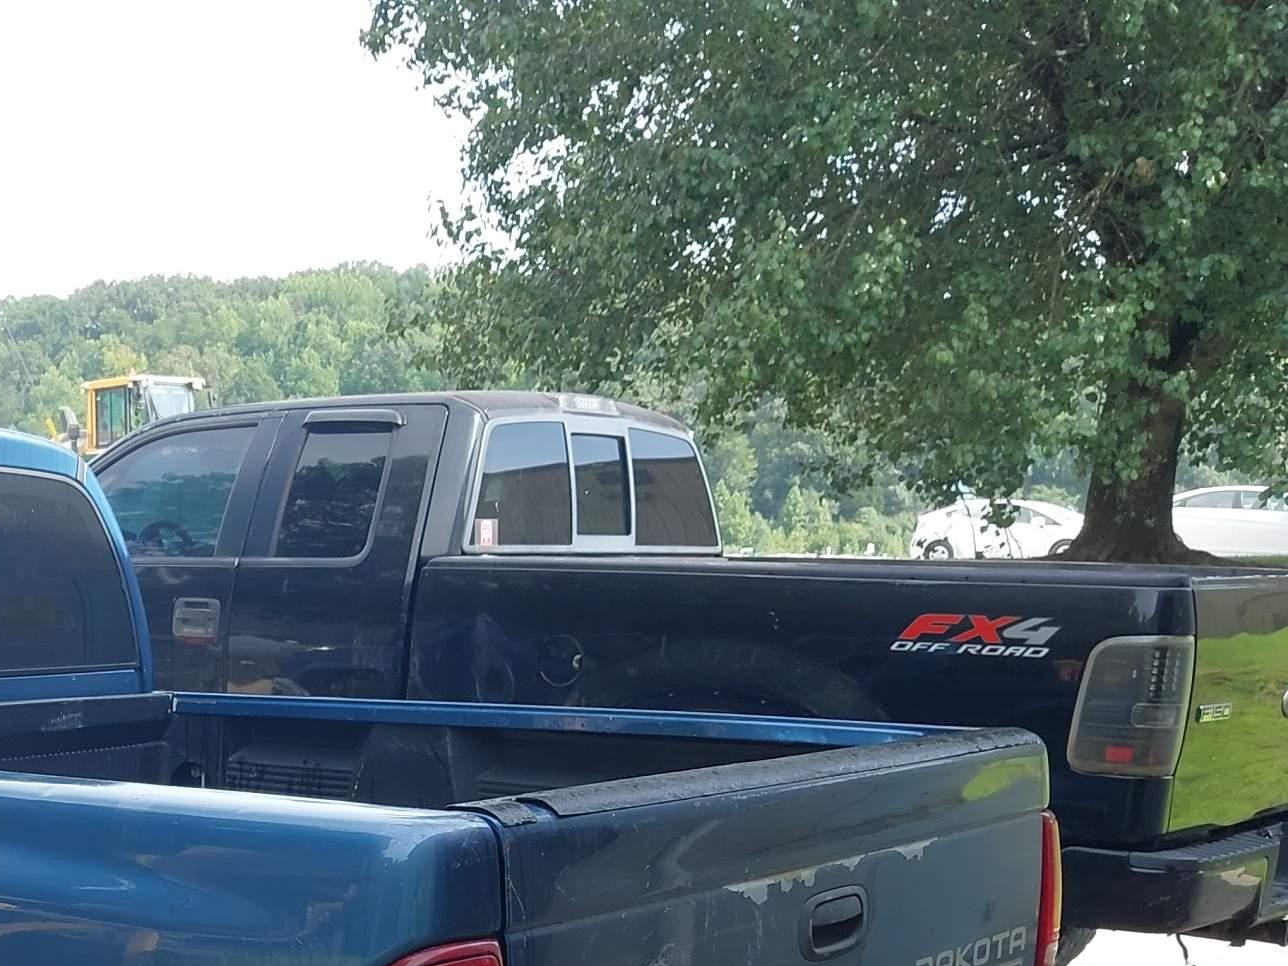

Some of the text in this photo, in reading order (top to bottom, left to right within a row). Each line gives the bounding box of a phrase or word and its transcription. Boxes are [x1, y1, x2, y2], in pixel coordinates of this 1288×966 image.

[898, 613, 1061, 644] FX4
[890, 640, 1050, 659] OFF ROAD
